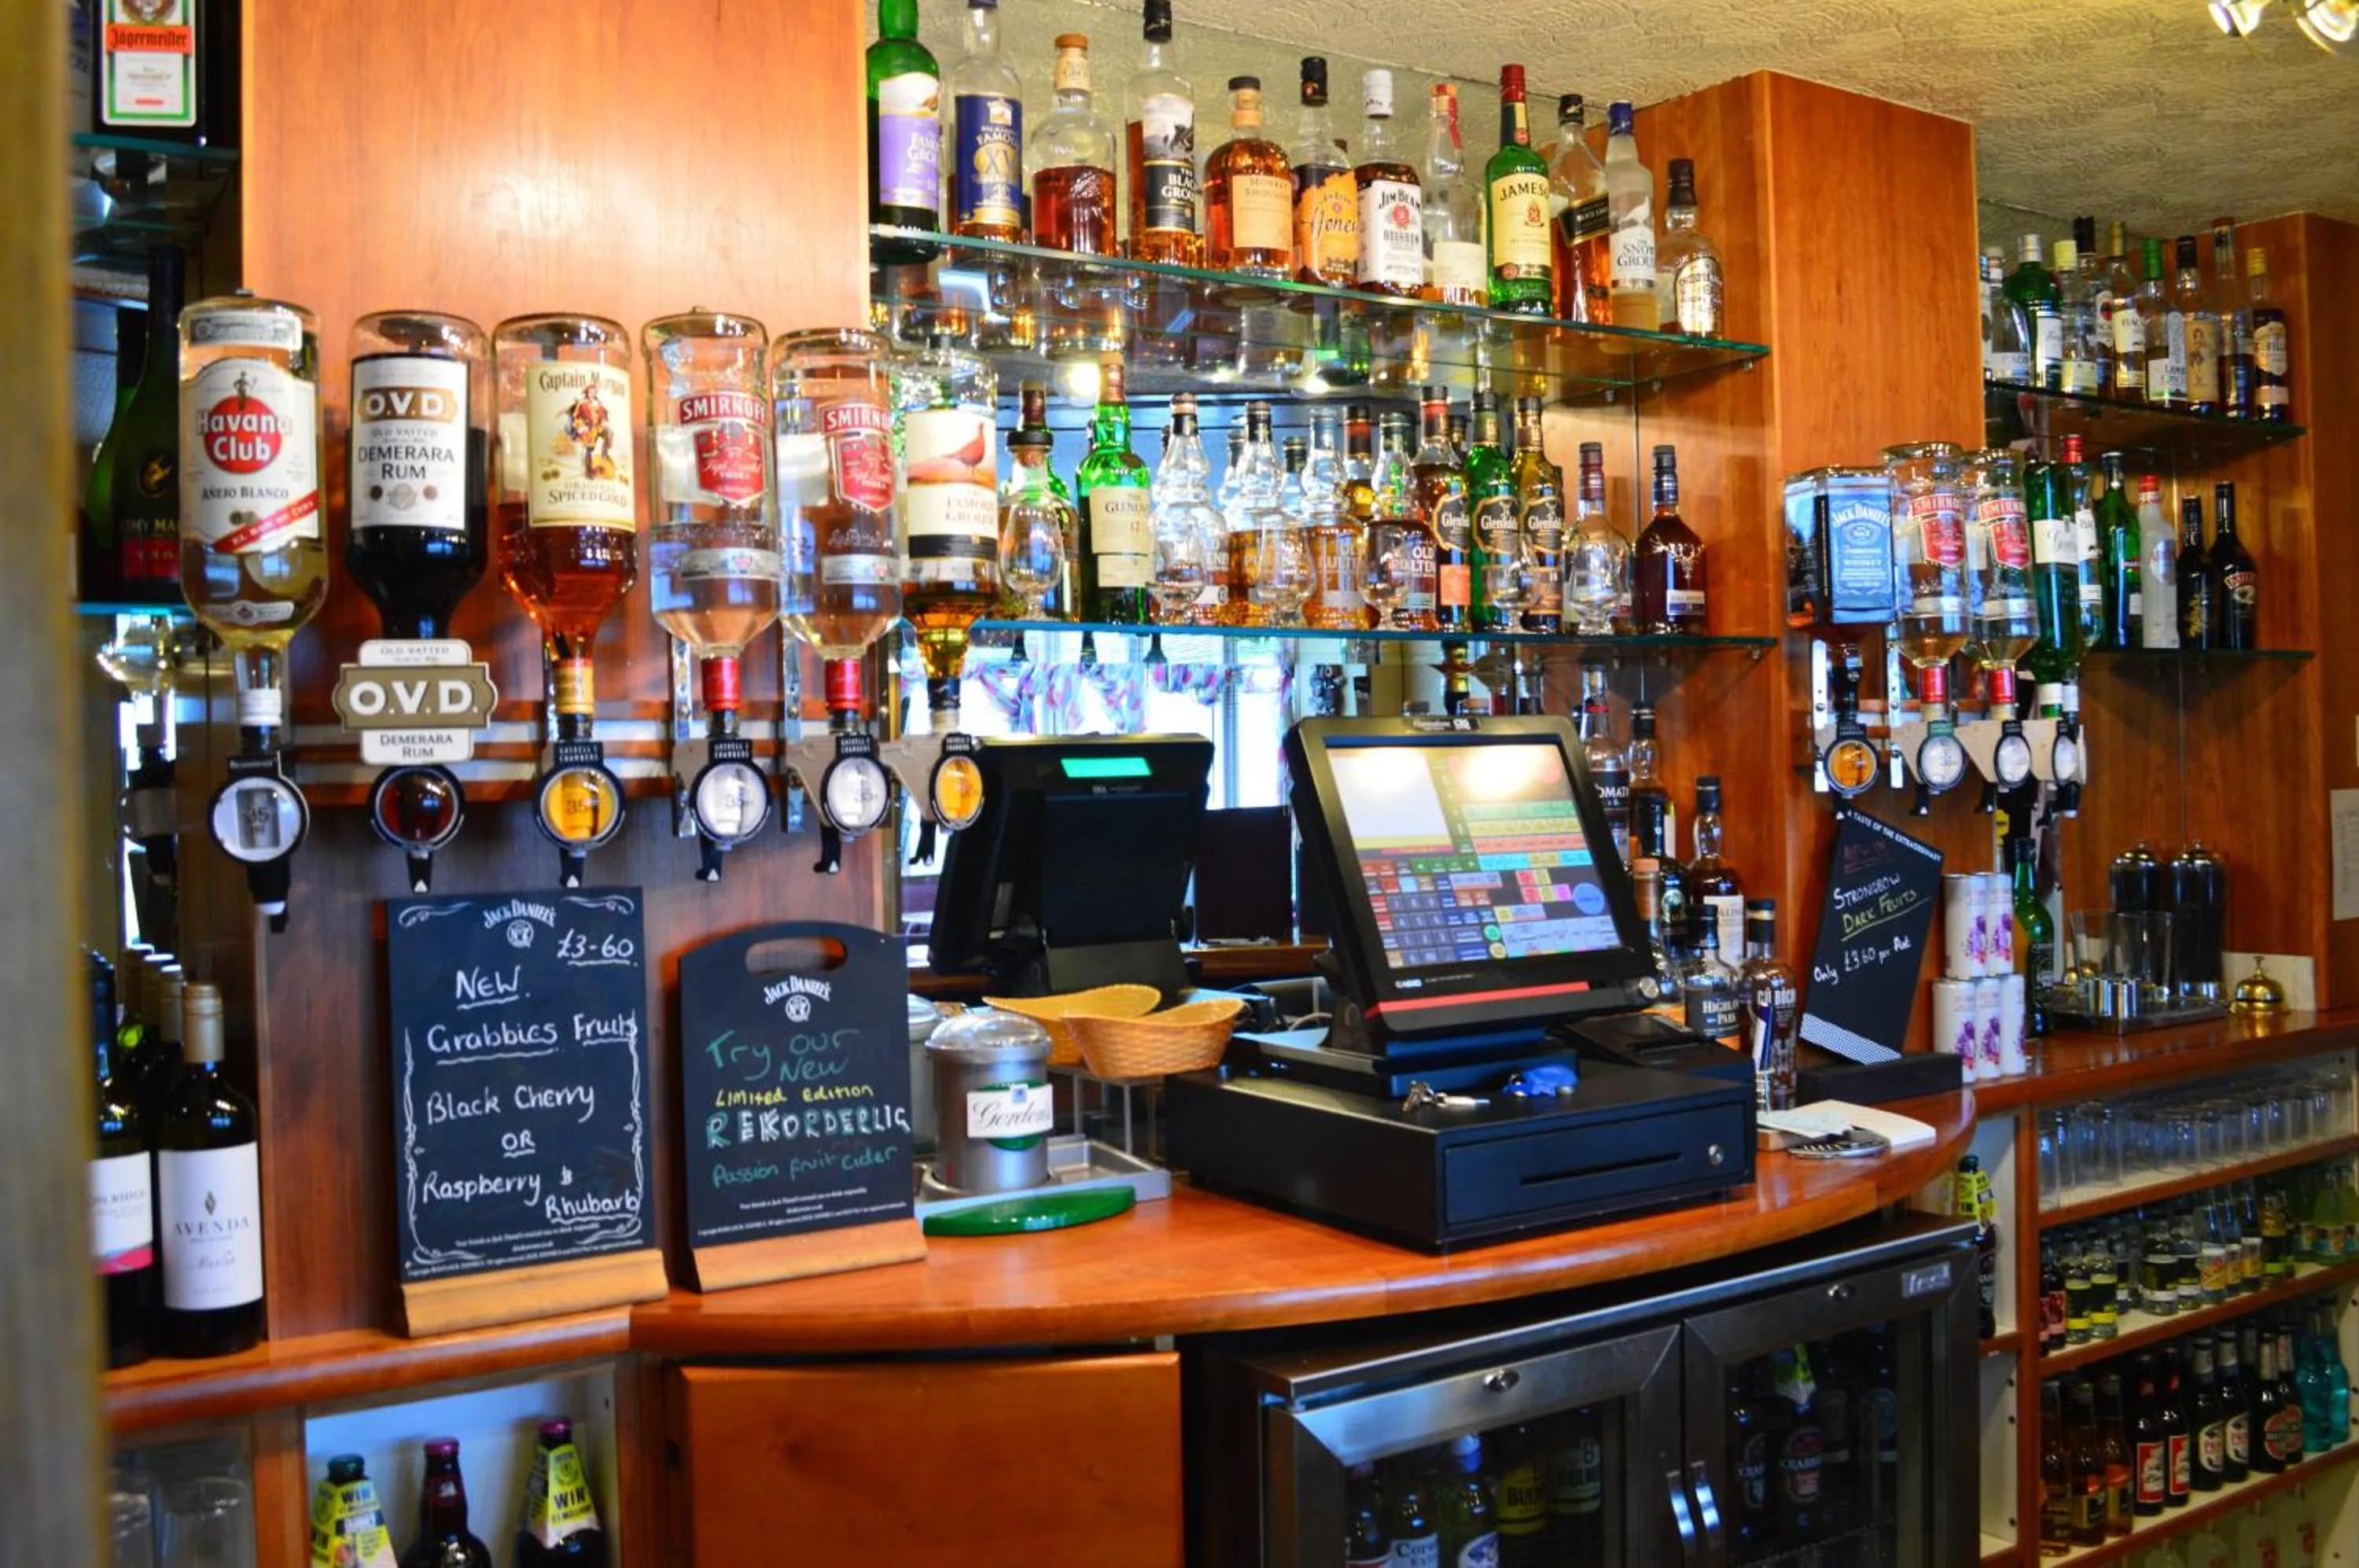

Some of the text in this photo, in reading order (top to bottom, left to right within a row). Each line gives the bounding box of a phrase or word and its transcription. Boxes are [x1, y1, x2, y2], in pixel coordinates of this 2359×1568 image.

[539, 370, 586, 392] Captain
[197, 410, 292, 436] Havana
[213, 436, 271, 462] Club
[358, 445, 455, 464] DEMERARA
[381, 462, 427, 480] RUM
[240, 485, 289, 500] BLANCO
[547, 489, 598, 504] SPICED
[349, 680, 479, 716] O.V.D.
[380, 734, 454, 746] DEMERARA
[402, 747, 435, 758] RUM
[1833, 874, 1901, 911] STRONGBOW
[484, 899, 558, 929] JACK DANIEL'S
[1813, 963, 1839, 985] Only
[764, 975, 832, 1006] JACK DANIEL'S
[705, 1029, 771, 1081] Try
[426, 1086, 502, 1125] Black
[501, 1128, 536, 1150] OR
[422, 1170, 541, 1207] Raspberry
[545, 1190, 639, 1220] Rhubarb
[173, 1216, 252, 1238] AVENDA
[554, 1485, 587, 1510] WIN
